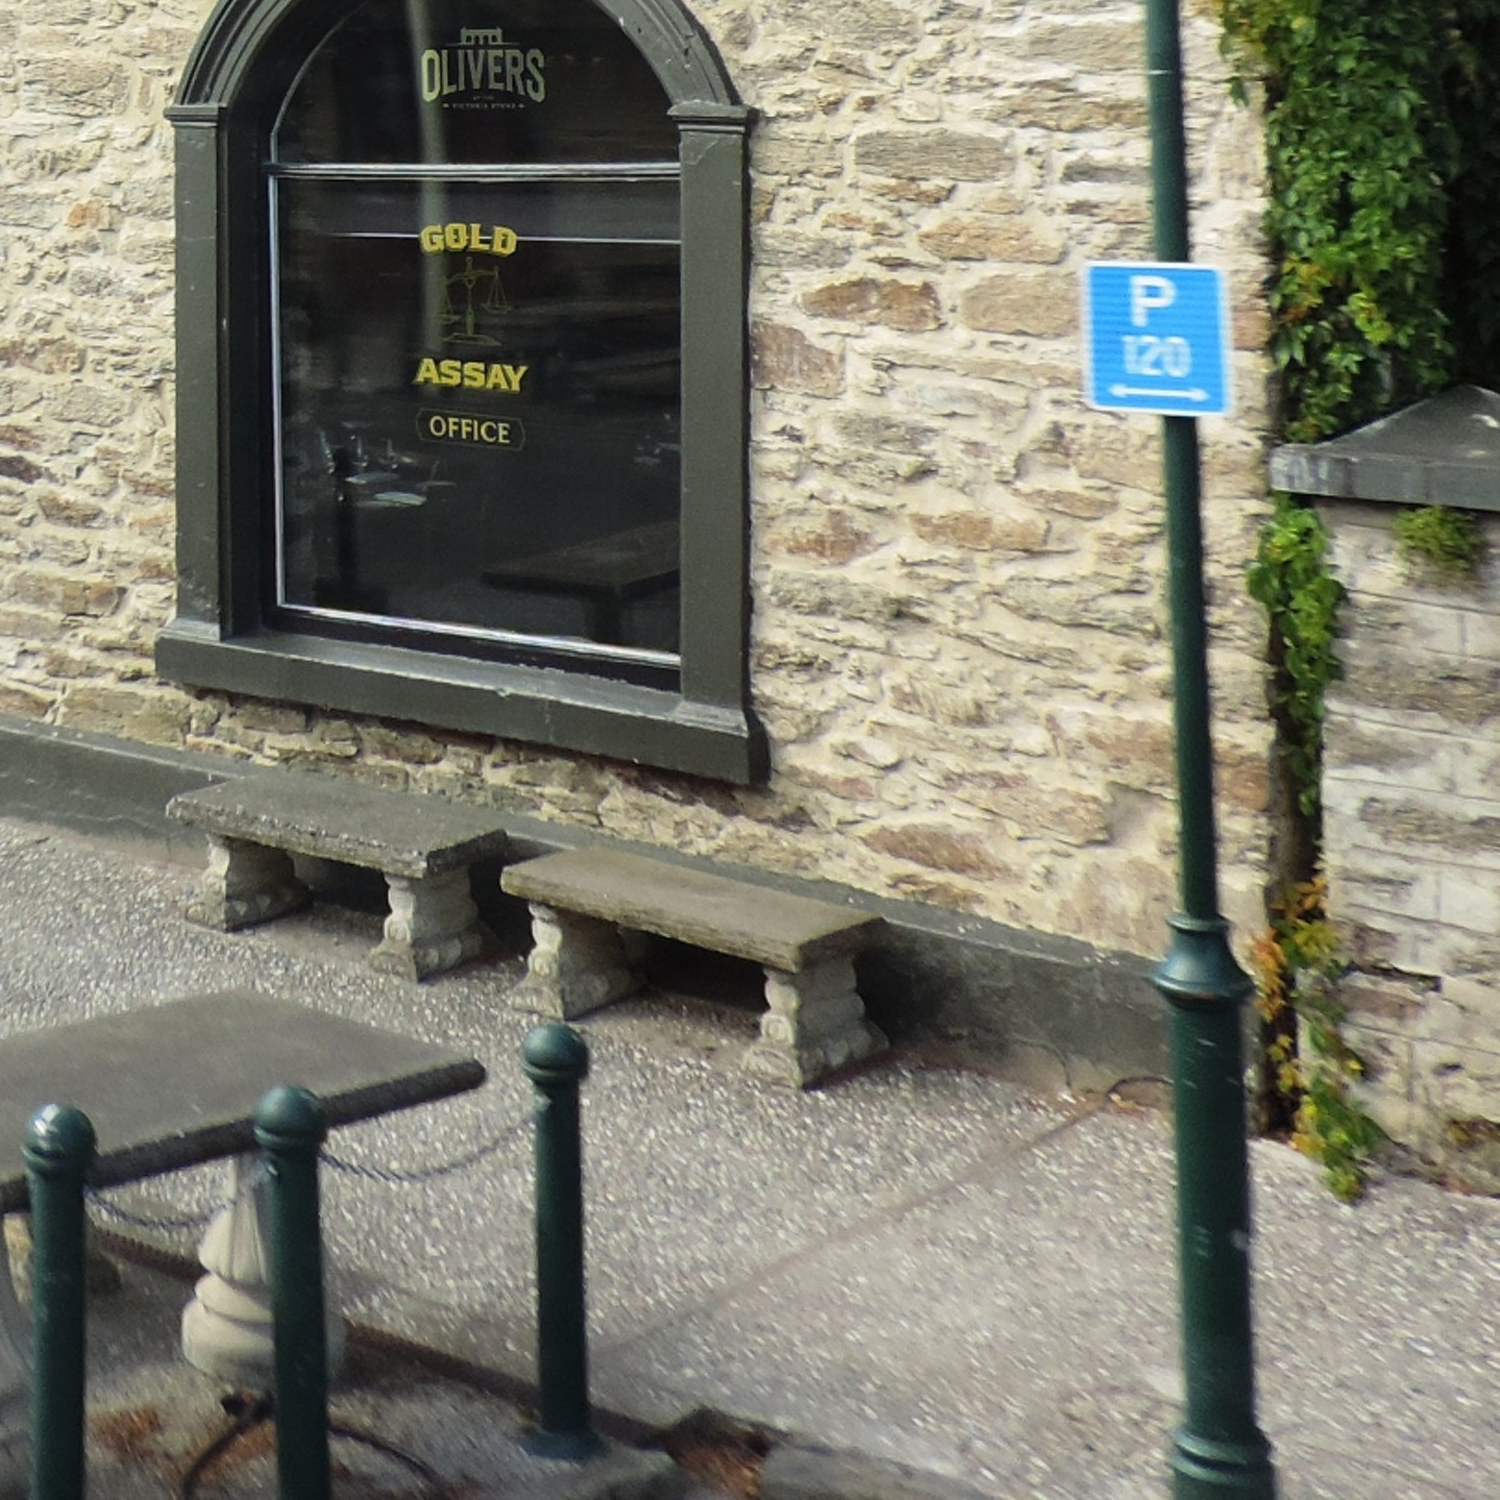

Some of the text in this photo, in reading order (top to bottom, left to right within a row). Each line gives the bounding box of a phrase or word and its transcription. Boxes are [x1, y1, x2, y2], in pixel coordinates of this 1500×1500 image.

[421, 48, 545, 102] OLIVERS
[419, 223, 518, 257] GOLD
[1130, 275, 1177, 327] P
[412, 357, 528, 392] ASSAY
[1122, 335, 1191, 378] 120
[429, 415, 511, 444] OFFICE
